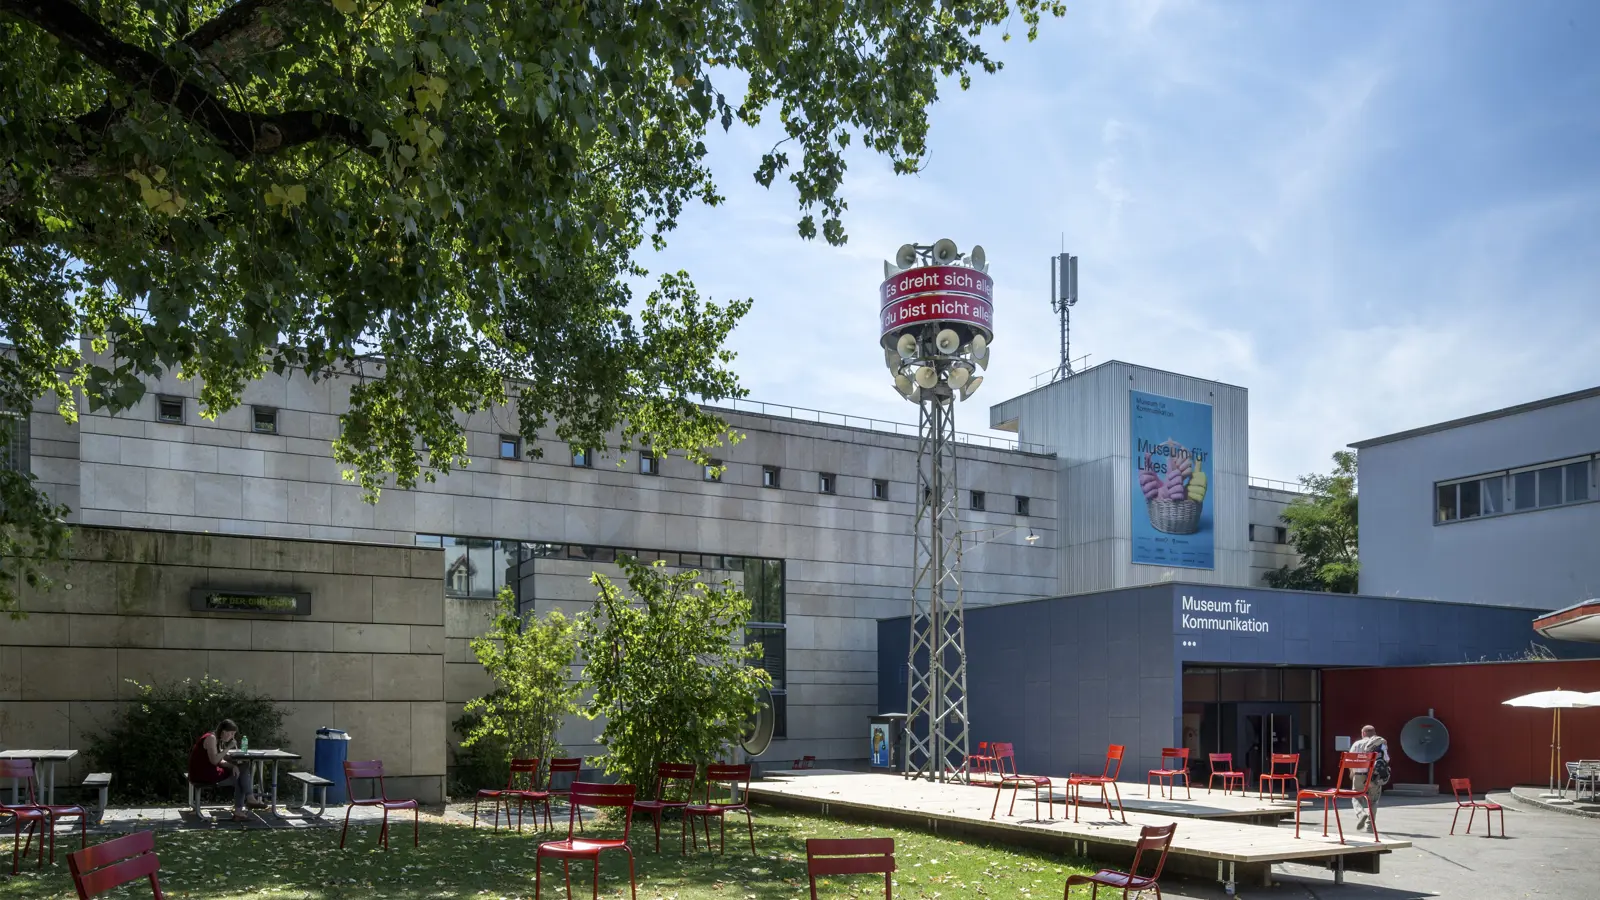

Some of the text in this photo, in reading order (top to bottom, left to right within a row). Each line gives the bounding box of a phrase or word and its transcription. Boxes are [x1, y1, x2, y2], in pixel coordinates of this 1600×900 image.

[886, 284, 896, 298] Es
[900, 273, 939, 291] dreht
[944, 272, 973, 287] sich
[885, 312, 896, 326] du
[900, 302, 926, 320] bist
[931, 300, 969, 315] nicht
[1137, 437, 1209, 463] Museum für
[1137, 455, 1168, 475] Likes
[1182, 595, 1251, 614] Museum für
[1182, 613, 1269, 633] Kommunikation
